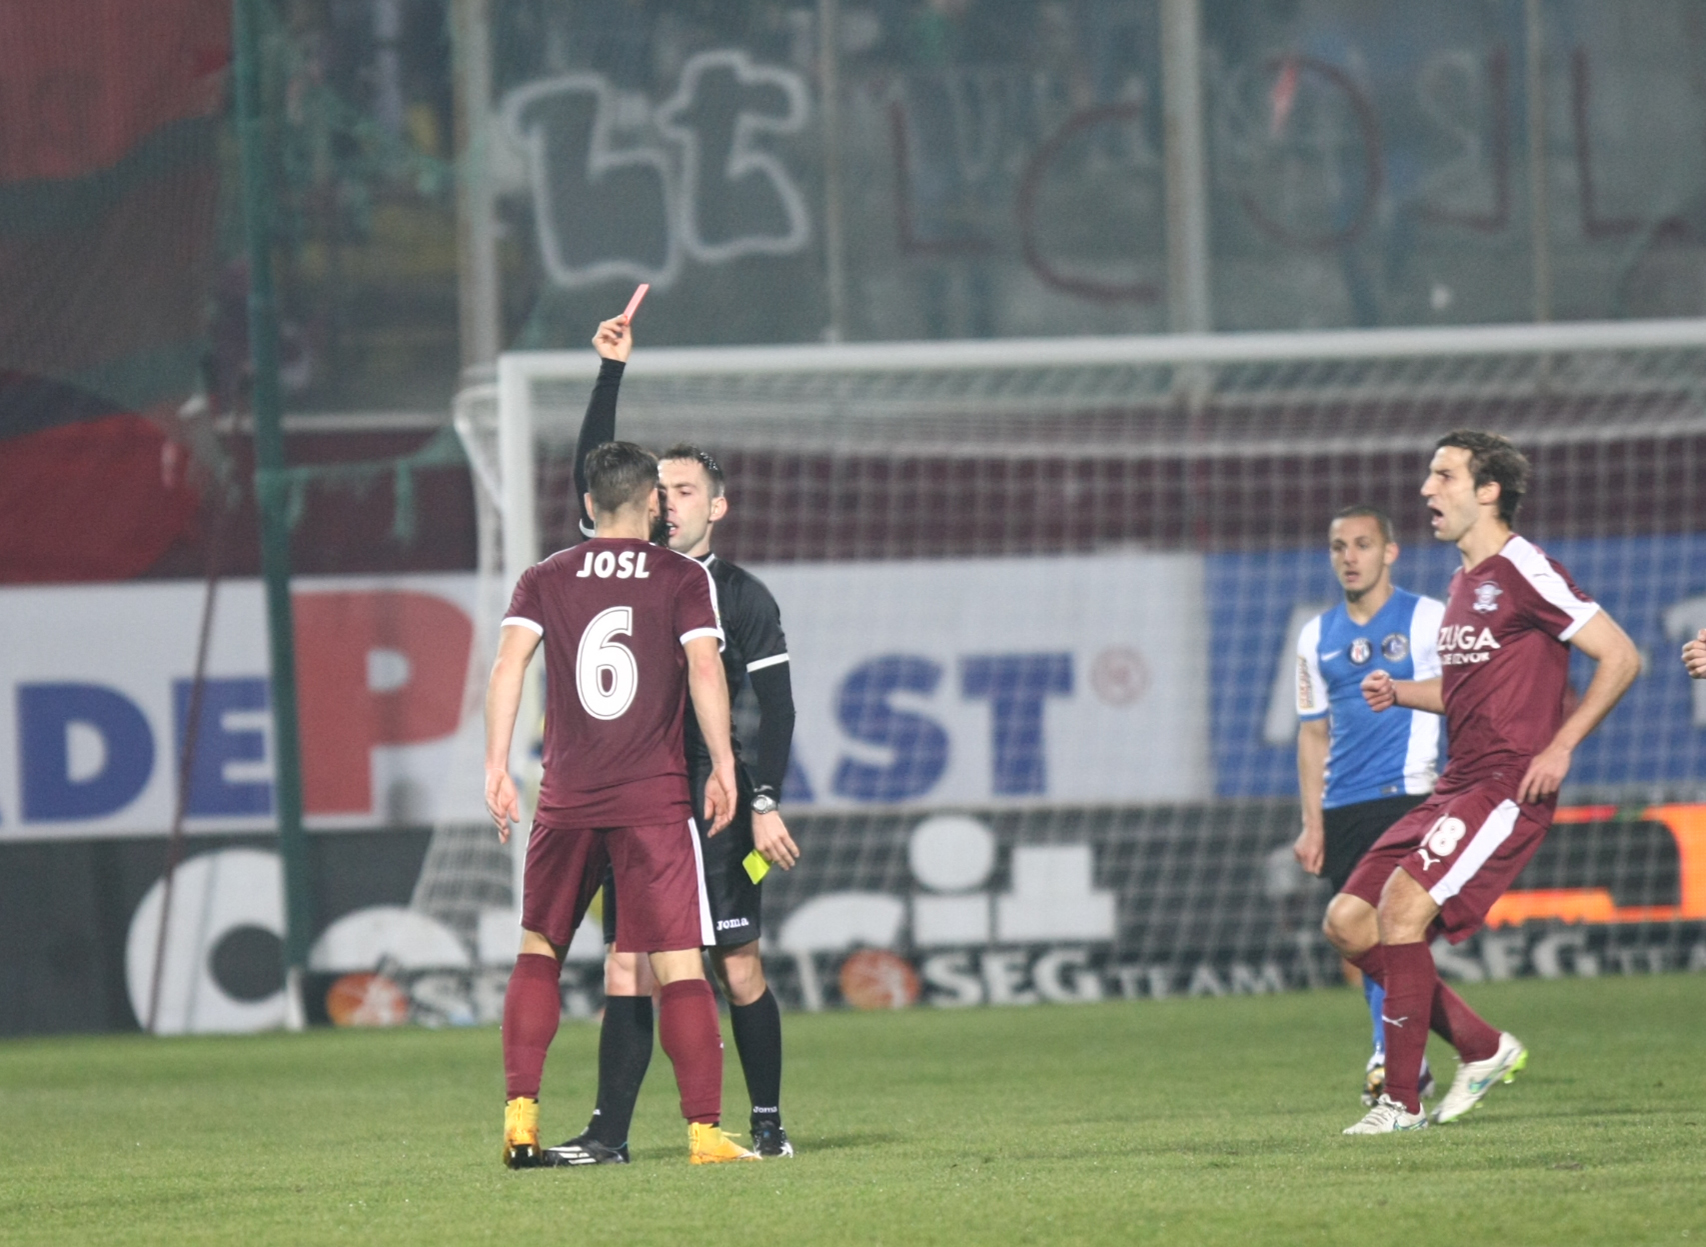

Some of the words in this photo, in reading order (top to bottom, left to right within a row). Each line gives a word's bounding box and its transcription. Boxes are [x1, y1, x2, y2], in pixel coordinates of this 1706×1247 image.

[576, 551, 650, 579] JOSL
[576, 606, 638, 720] 6
[921, 949, 1104, 1009] SEG
[1103, 963, 1285, 1000] TEAM
